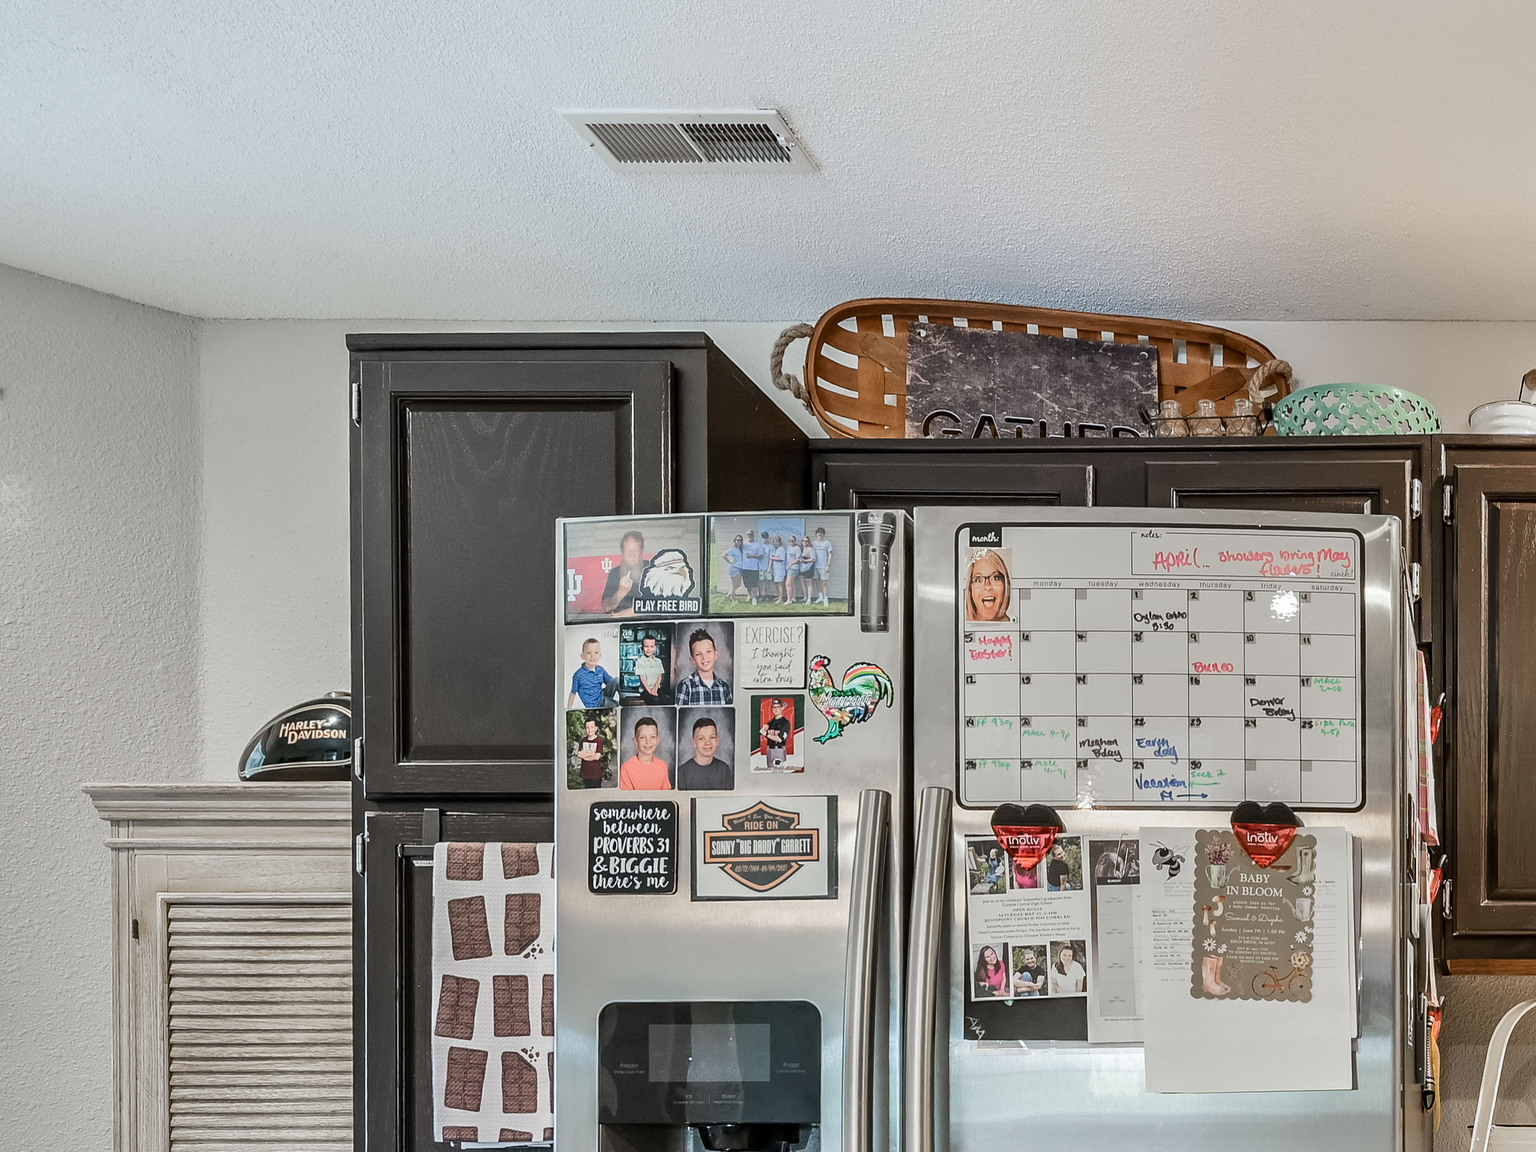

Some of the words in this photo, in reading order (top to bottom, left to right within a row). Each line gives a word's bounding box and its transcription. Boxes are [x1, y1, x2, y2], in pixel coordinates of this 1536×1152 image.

[635, 600, 655, 612] PLAY
[657, 600, 677, 612] FREE
[679, 600, 699, 612] BIRD
[745, 626, 803, 644] EXERCISE?
[964, 633, 973, 643] 5
[1190, 633, 1197, 642] 9
[751, 647, 759, 660] I
[762, 647, 796, 662] thought
[757, 664, 771, 675] you
[774, 660, 792, 672] said
[966, 675, 976, 684] 12
[1190, 676, 1200, 685] 16
[1134, 717, 1146, 727] 22
[1245, 719, 1256, 727] 24
[1301, 720, 1313, 729] 25
[287, 729, 347, 744] DAVIDSON
[593, 804, 671, 821] somewhere
[603, 820, 662, 835] between
[744, 821, 764, 830] RIDE
[766, 820, 779, 830] ON
[593, 836, 654, 854] PROVERBS
[656, 837, 670, 853] 31
[711, 840, 735, 855] SONNY
[780, 838, 811, 854] GARRETT
[592, 855, 608, 873] &
[609, 856, 669, 875] BIGGIE
[592, 873, 642, 889] there's
[646, 876, 669, 889] me
[1240, 873, 1270, 884] BABY
[1226, 885, 1239, 895] IN
[1242, 887, 1283, 897] BLOOM
